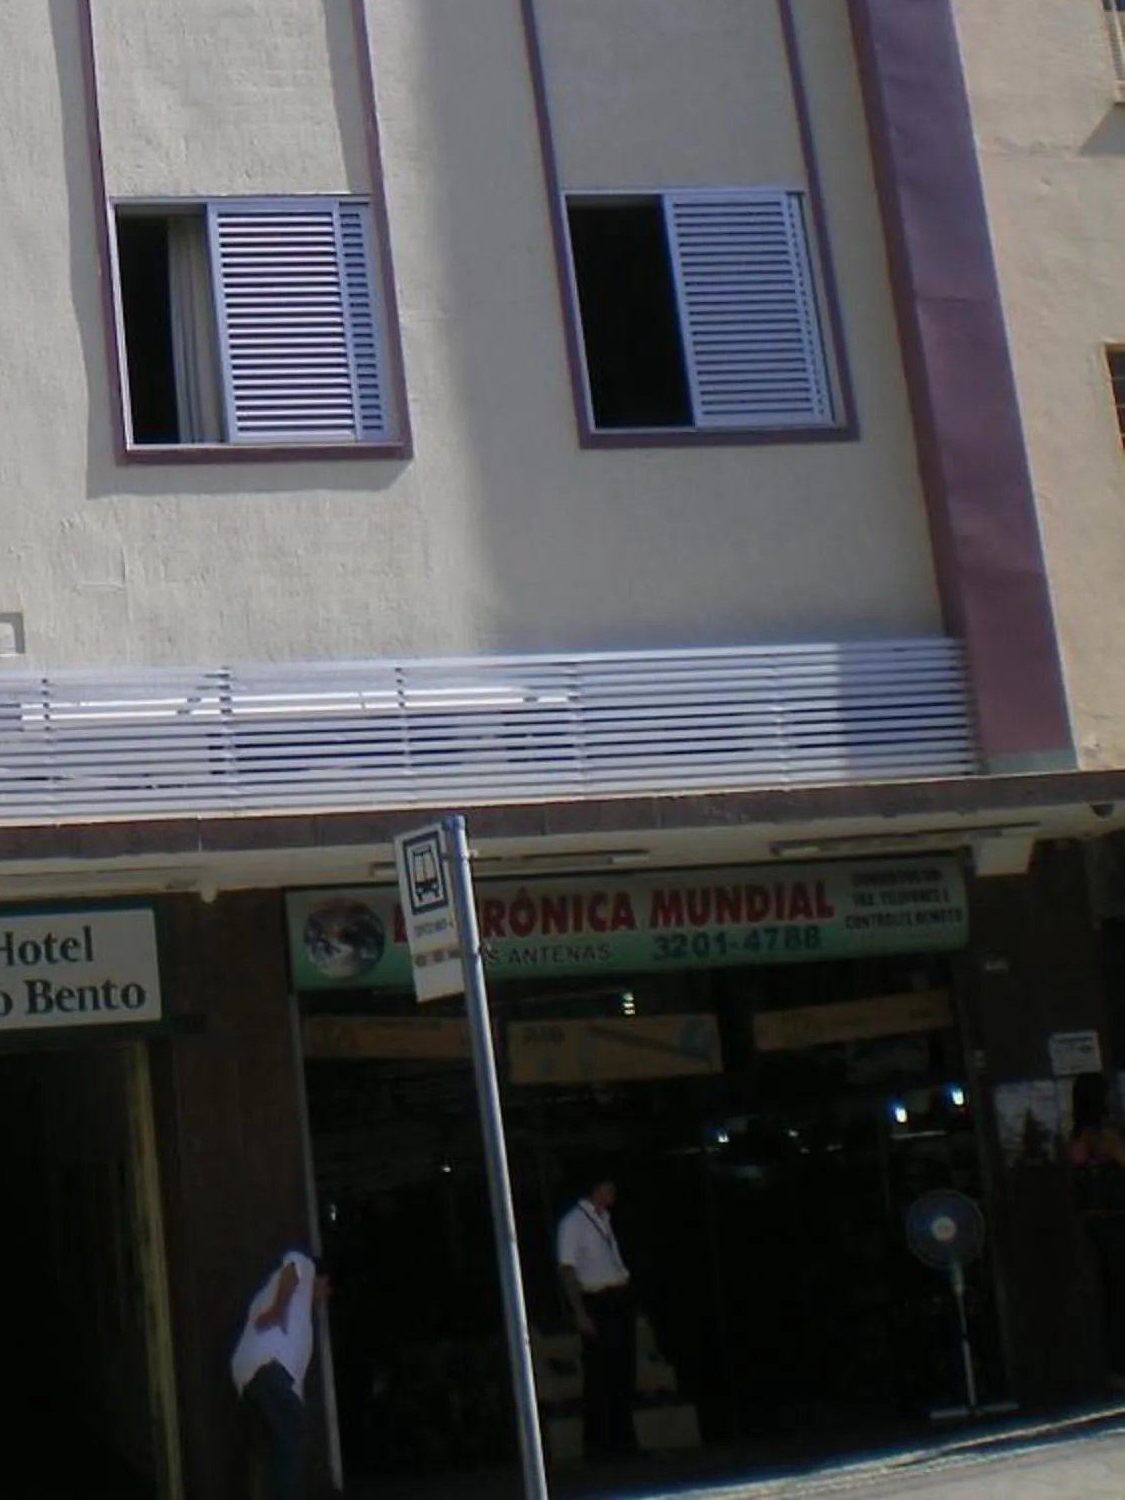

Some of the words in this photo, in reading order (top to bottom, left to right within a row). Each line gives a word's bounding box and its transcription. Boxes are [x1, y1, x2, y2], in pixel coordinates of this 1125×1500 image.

[649, 880, 835, 929] MUNDIAL
[508, 942, 611, 966] ANTENAS
[23, 977, 147, 1016] Bento
